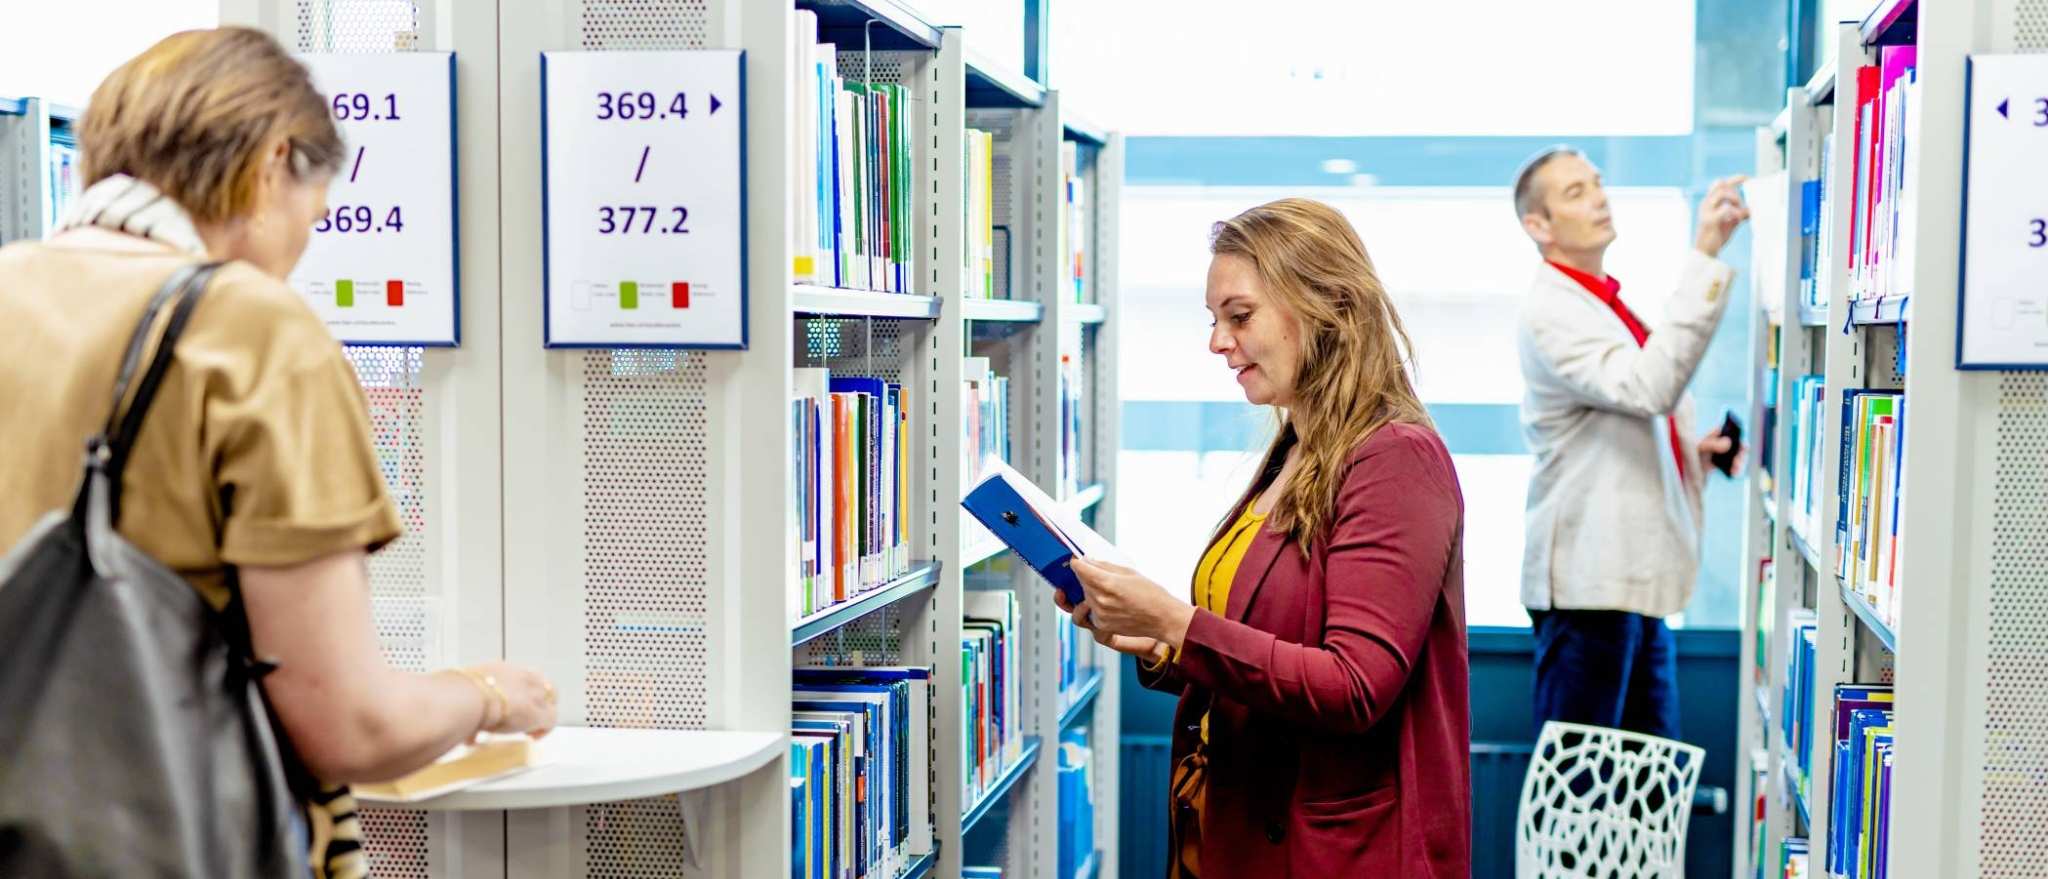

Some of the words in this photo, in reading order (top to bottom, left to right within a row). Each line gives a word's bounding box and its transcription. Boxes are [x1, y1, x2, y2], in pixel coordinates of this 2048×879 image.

[332, 93, 401, 121] 69.1
[598, 92, 689, 120] 369.4
[351, 146, 365, 183] /
[634, 145, 651, 183] /
[600, 206, 690, 235] 377.2
